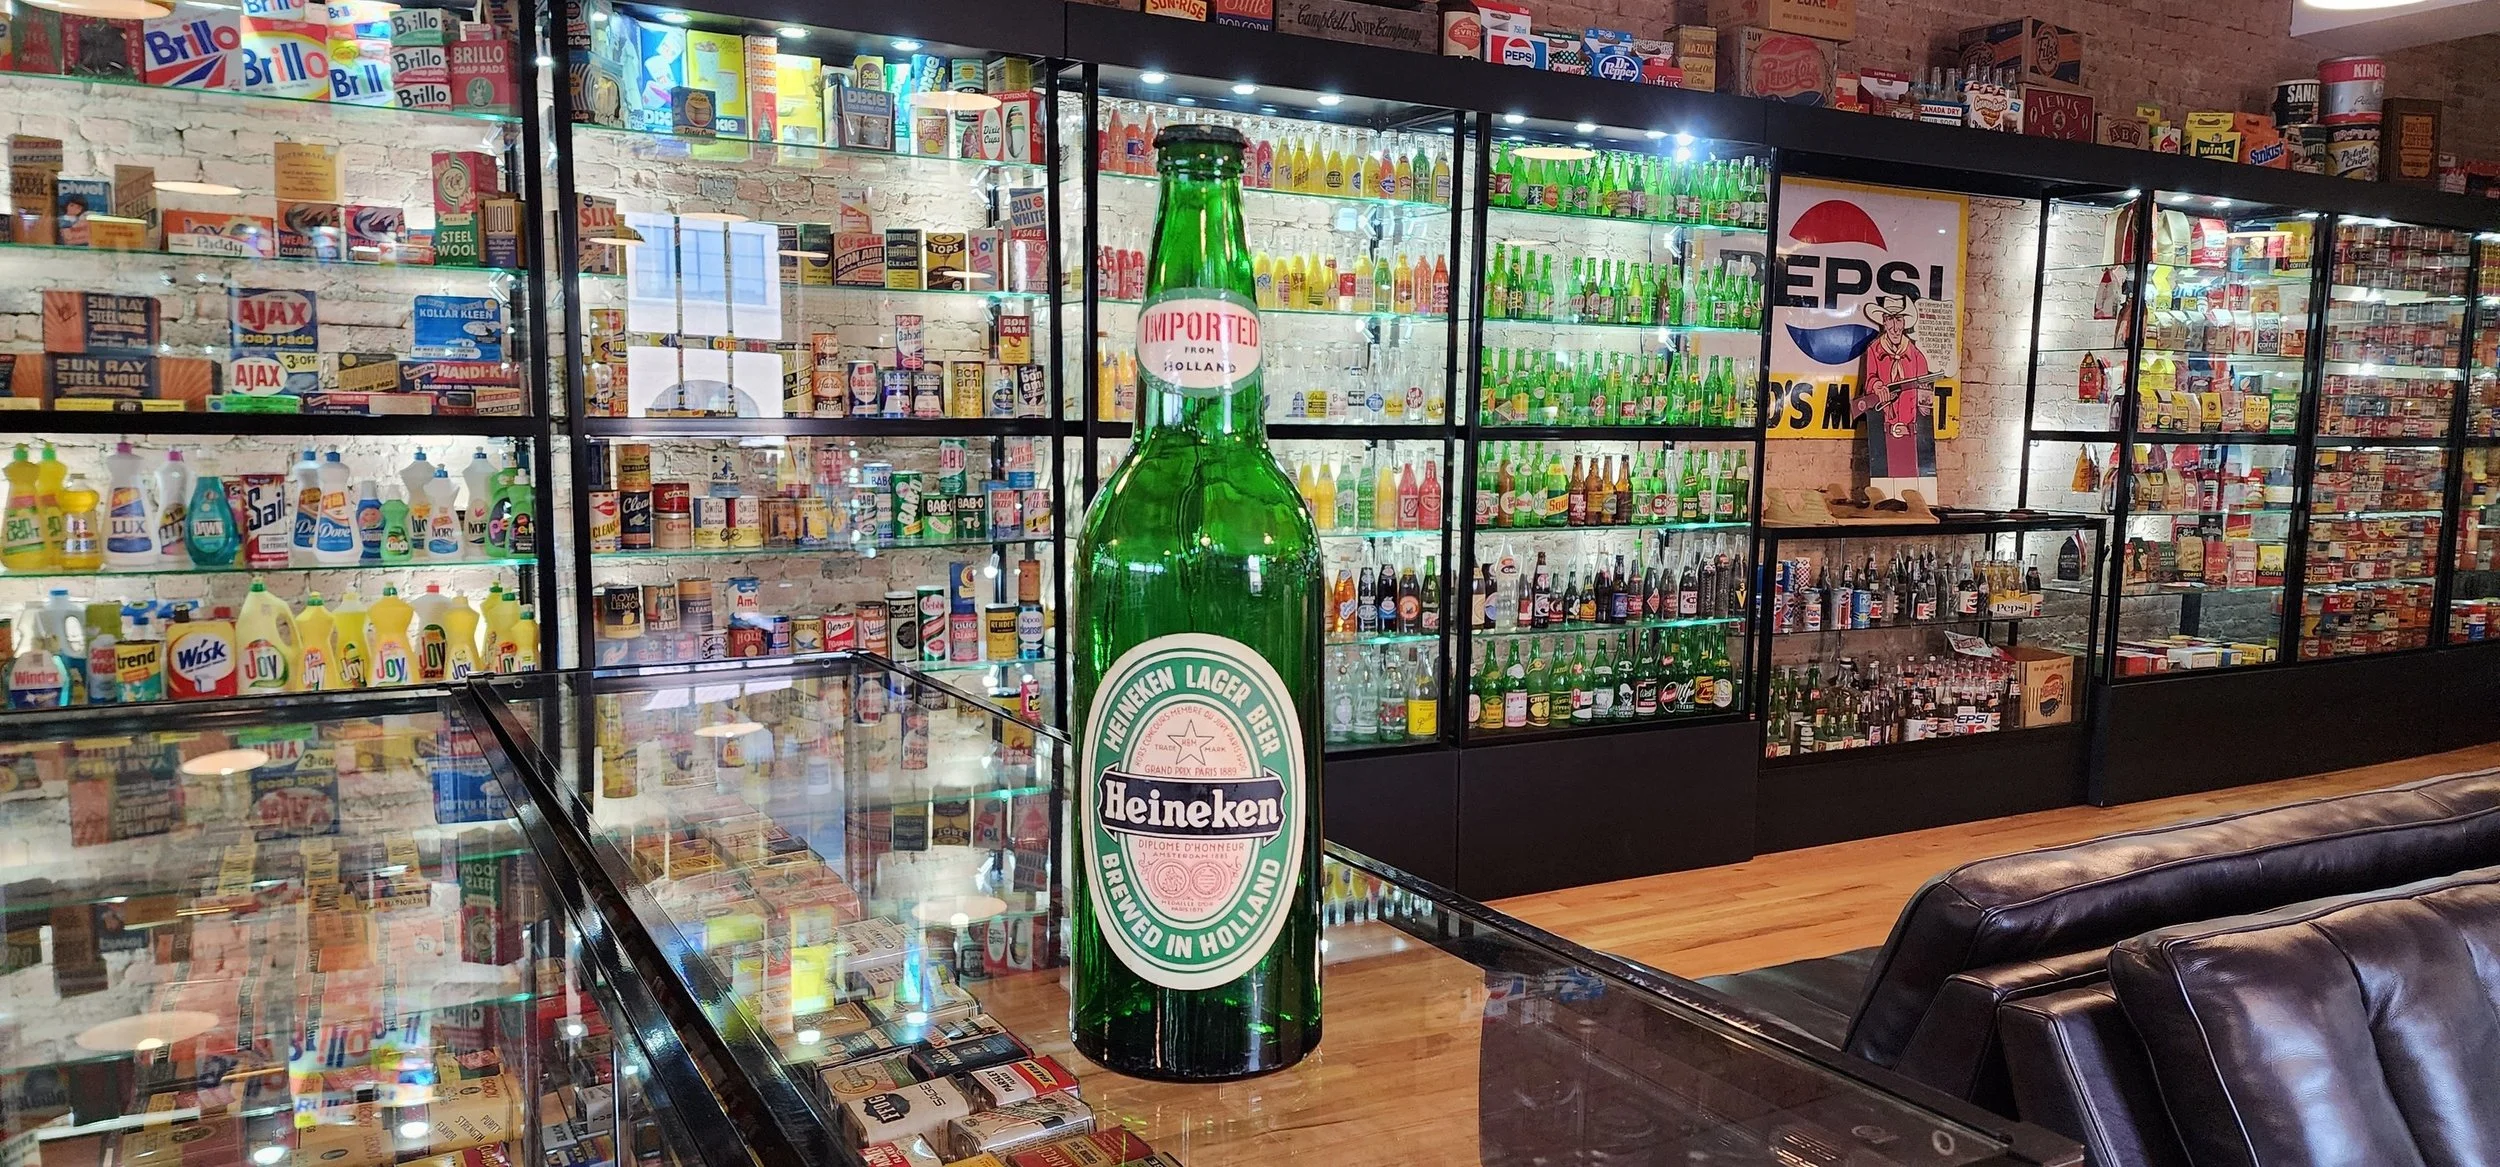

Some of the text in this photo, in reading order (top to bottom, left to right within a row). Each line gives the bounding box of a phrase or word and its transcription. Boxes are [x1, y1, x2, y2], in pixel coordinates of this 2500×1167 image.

[1151, 0, 1205, 20] SUN-RISE
[392, 12, 438, 36] Brillo
[145, 20, 241, 66] Brillo
[1747, 31, 1762, 42] BUY
[453, 45, 504, 64] BRILLO
[1684, 41, 1715, 55] MAZOLA
[243, 43, 329, 87] Brillo
[394, 49, 442, 73] Brillo
[1504, 51, 1535, 64] PEPSI
[1615, 57, 1630, 69] Dr
[453, 65, 505, 74] SOAP PADS
[1603, 64, 1637, 79] Pepper
[2353, 63, 2381, 78] KING
[398, 86, 446, 108] Brillo
[1921, 104, 1961, 116] CANADA DRY
[2038, 96, 2080, 120] LEWIS
[2200, 140, 2231, 156] wink
[2249, 142, 2284, 166] Sunkist
[1012, 197, 1032, 214] BLU
[487, 205, 513, 233] WOW
[580, 207, 617, 228] SLIX
[1011, 209, 1046, 227] WHITE
[441, 230, 473, 242] STEEL
[196, 234, 244, 256] Paddy
[437, 244, 477, 257] WOOL
[931, 243, 959, 254] TOPS
[838, 247, 882, 267] BON AMI
[89, 299, 146, 311] SUN RAY
[88, 311, 147, 325] STEEL WOOL
[238, 299, 308, 331] AJAX
[420, 308, 494, 320] KOLLAR KLEEN
[1003, 318, 1026, 326] BON
[1003, 326, 1027, 334] AMI
[1145, 312, 1257, 347] IMPORTED
[235, 334, 314, 346] soap pads
[57, 358, 147, 373] SUN RAY
[1164, 362, 1236, 373] HOLLAND
[57, 373, 148, 387] STEEL WOOL
[235, 362, 280, 391] AJAX
[249, 481, 286, 531] Sail
[112, 520, 146, 534] LUX
[320, 522, 351, 538] Dove
[611, 593, 638, 601] ROYAL
[1995, 601, 2027, 615] Pepsi
[117, 646, 156, 669] trend
[177, 639, 227, 670] Wisk
[1103, 665, 1281, 757] HEINEKEN LAGER BEER
[1145, 764, 1237, 776] GRAND PRIX PARIS 1889
[1105, 779, 1279, 828] Heineken
[1138, 839, 1245, 852] DIPLOME D'HONNEUR
[1101, 853, 1281, 959] BREWED IN HOLLAND
[985, 1070, 1015, 1093] PARSLEY
[919, 1082, 946, 1107] SAGE
[435, 1121, 457, 1141] FLAVOR
[455, 1115, 486, 1143] STRENGTH
[481, 1114, 502, 1134] PURITY
